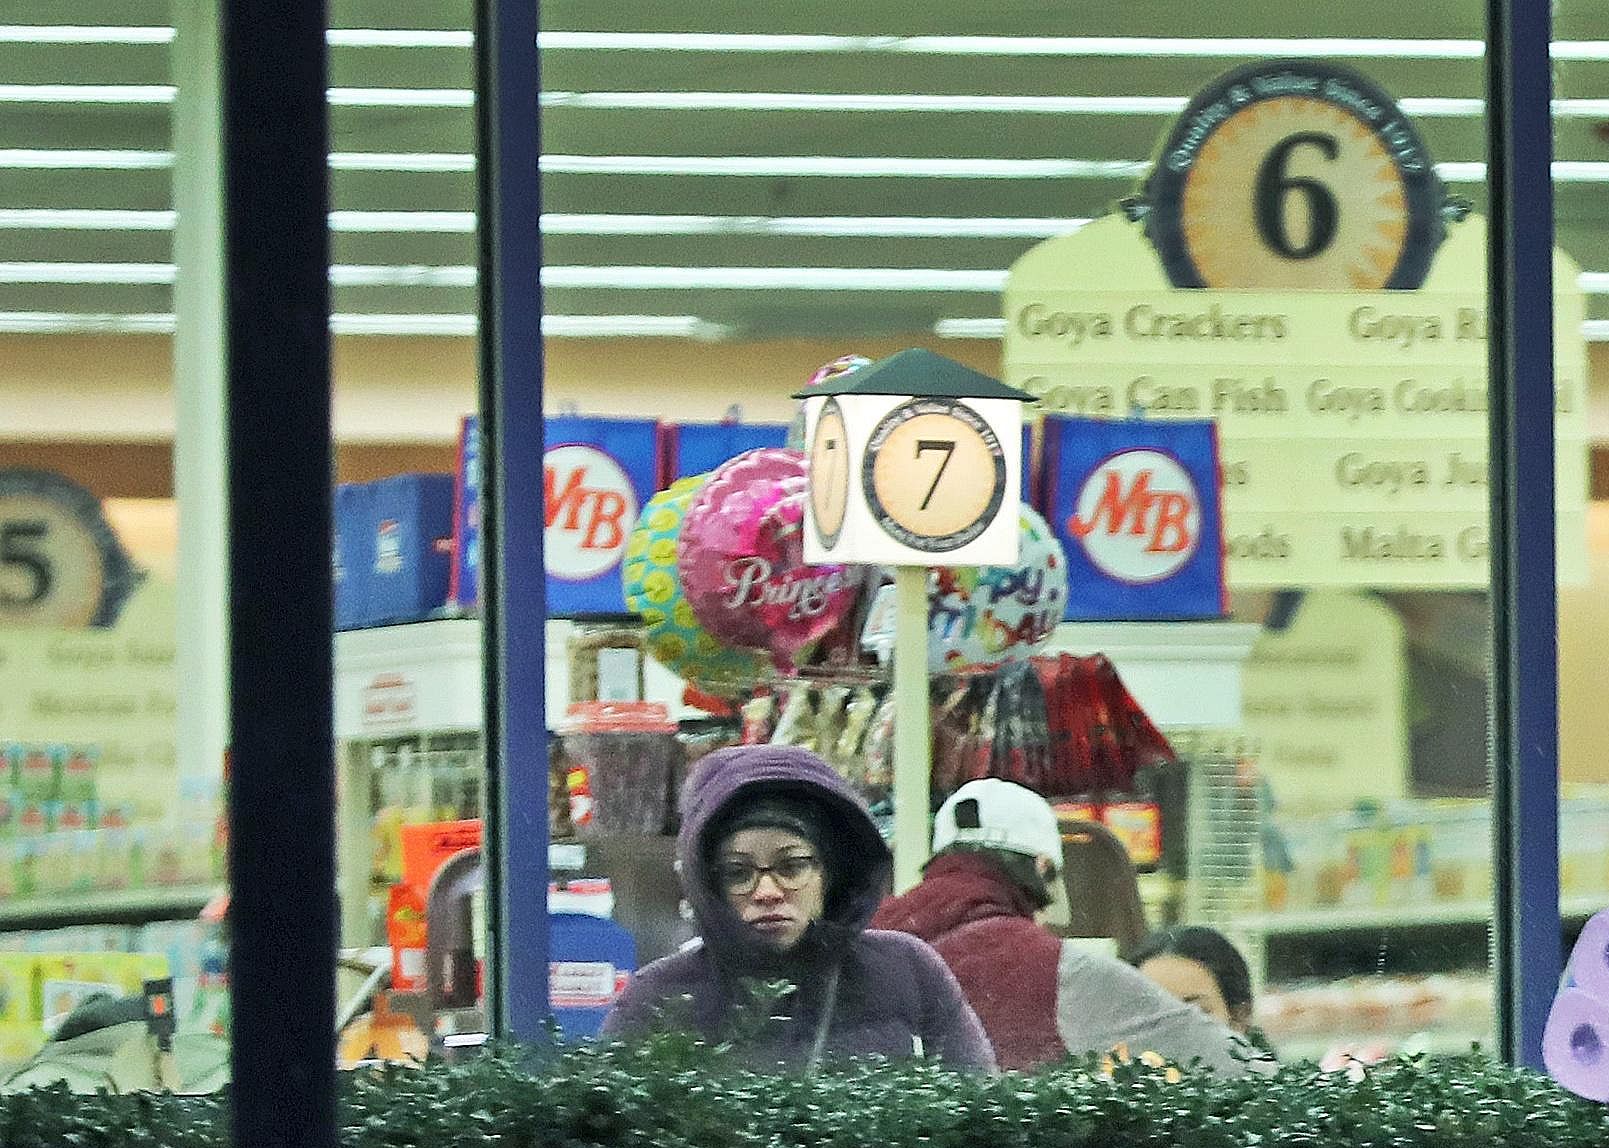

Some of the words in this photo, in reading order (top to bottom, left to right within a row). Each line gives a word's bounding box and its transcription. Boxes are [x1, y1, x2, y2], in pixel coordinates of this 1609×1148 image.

[1254, 131, 1340, 260] 6
[1018, 302, 1111, 350] Goya
[1123, 302, 1288, 341] Crackers
[1349, 305, 1441, 350] Goya
[1126, 375, 1203, 412] Can
[1212, 376, 1291, 413] Fish
[1304, 379, 1387, 424] Goya
[913, 438, 958, 511] 7
[1335, 452, 1427, 496] Goya
[1067, 469, 1192, 554] MB
[1340, 525, 1446, 560] Malta
